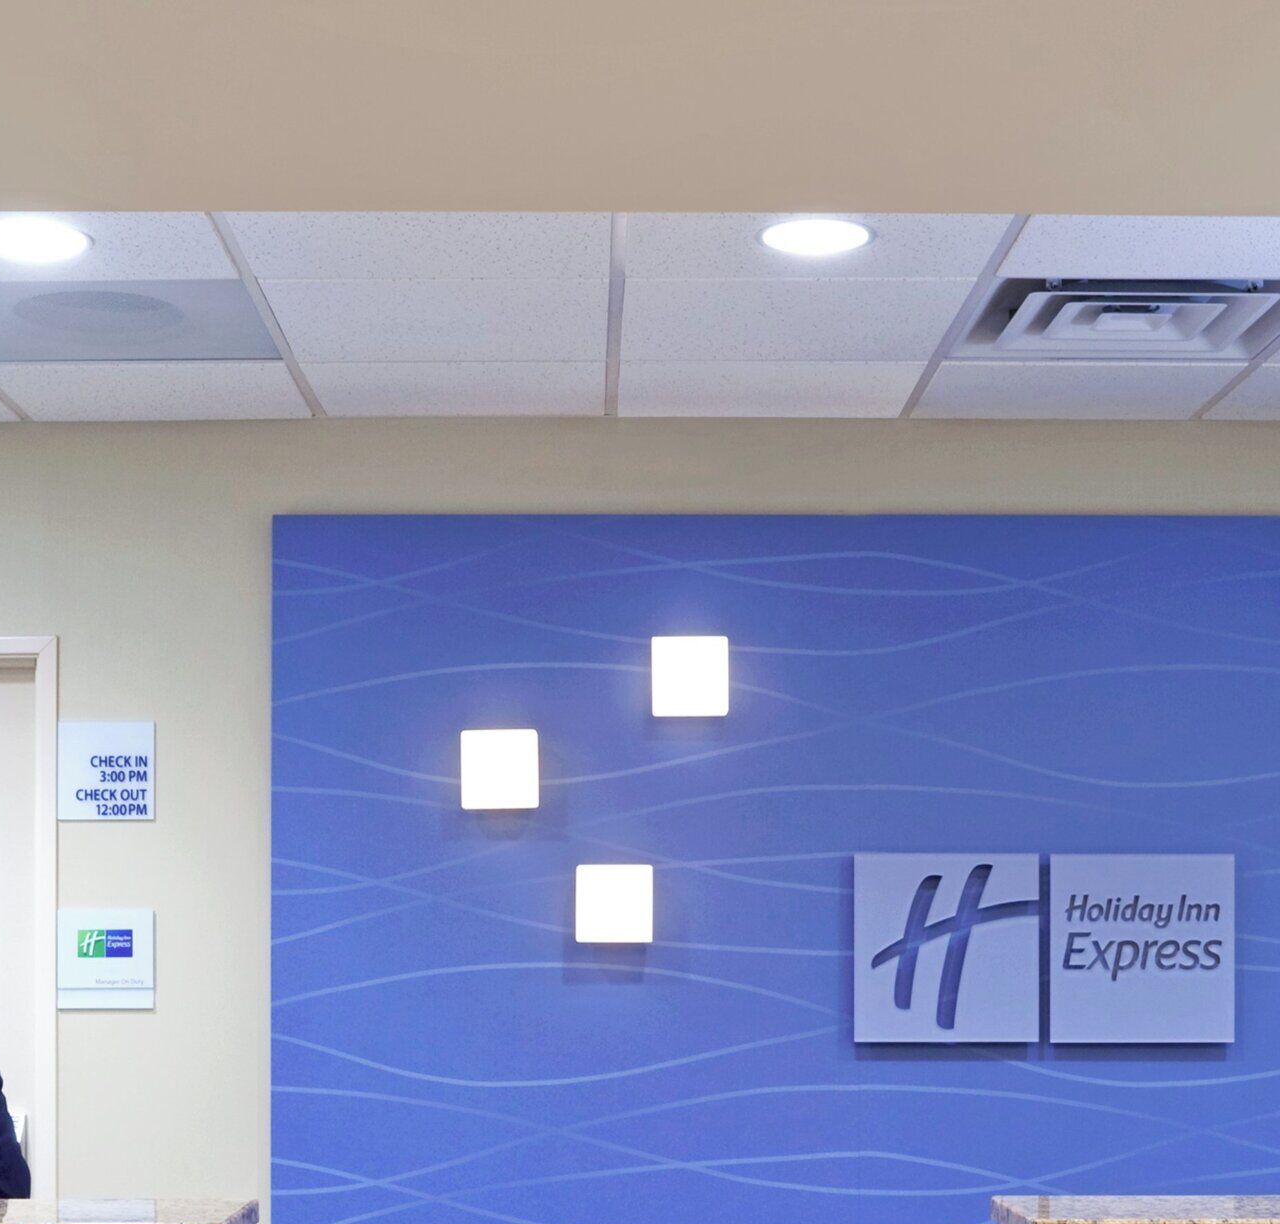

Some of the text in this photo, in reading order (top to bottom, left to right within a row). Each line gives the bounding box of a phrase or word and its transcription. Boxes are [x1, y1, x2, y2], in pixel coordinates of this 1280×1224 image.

[90, 755, 148, 768] CHECK IN
[100, 770, 148, 782] 3:00 PM
[76, 789, 147, 801] CHECK OUT
[96, 804, 148, 816] 12:00 PM
[1065, 894, 1220, 928] Holiday Inn
[107, 941, 131, 949] Express
[1062, 931, 1223, 982] Express
